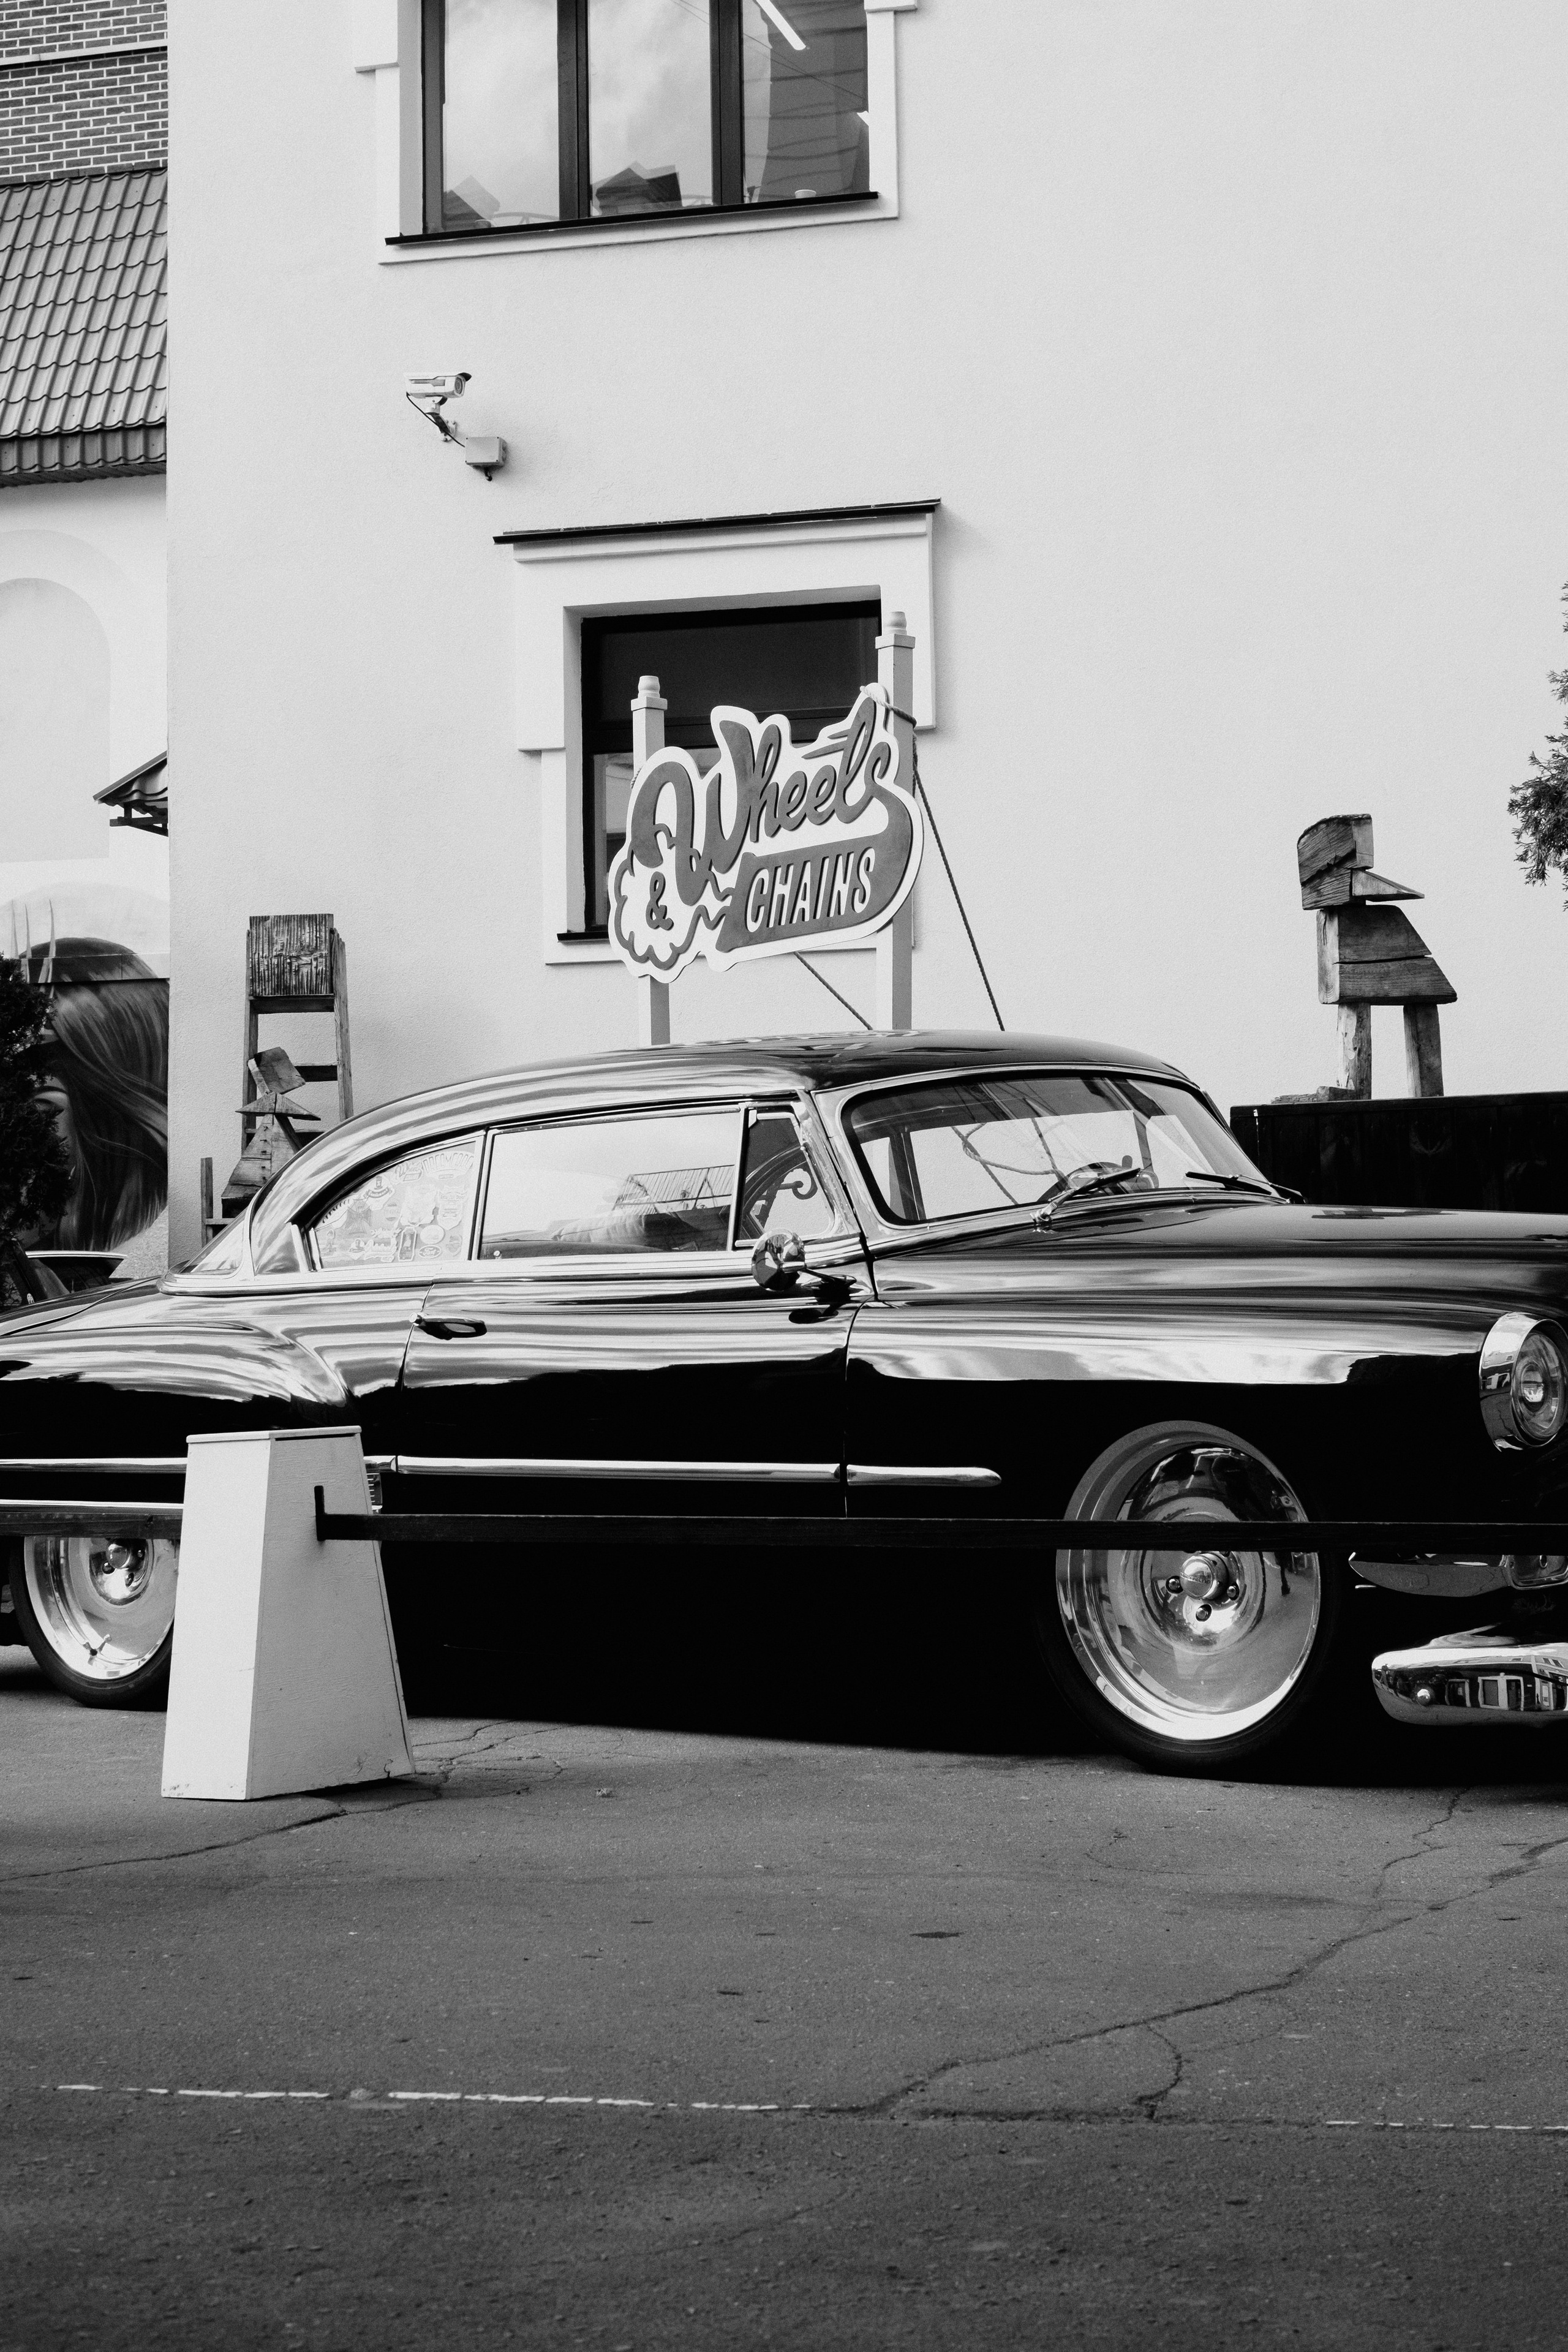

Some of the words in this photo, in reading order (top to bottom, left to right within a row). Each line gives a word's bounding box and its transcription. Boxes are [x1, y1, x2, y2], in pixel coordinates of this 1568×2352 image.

[631, 696, 891, 905] Wheels
[646, 871, 674, 930] &
[745, 847, 876, 933] CHAINS
